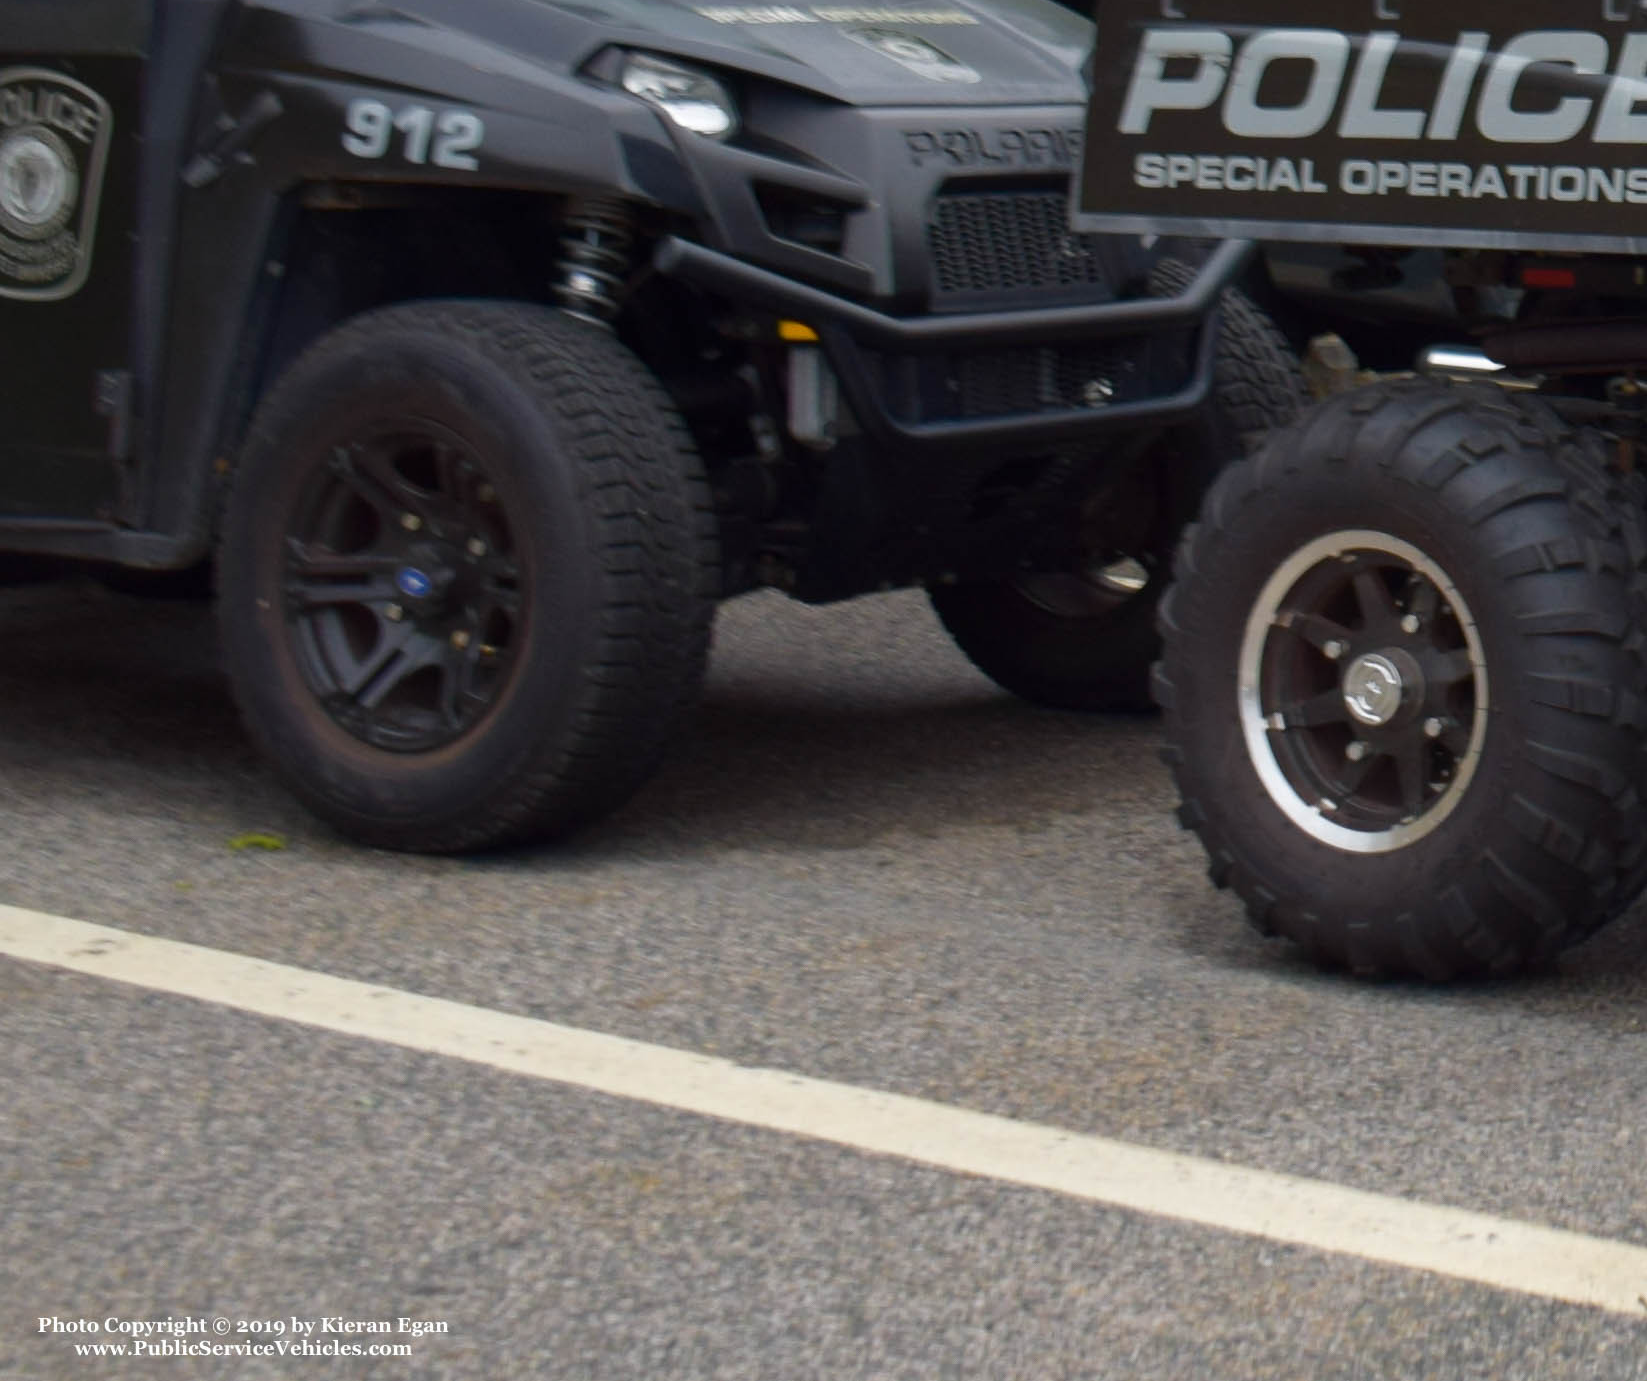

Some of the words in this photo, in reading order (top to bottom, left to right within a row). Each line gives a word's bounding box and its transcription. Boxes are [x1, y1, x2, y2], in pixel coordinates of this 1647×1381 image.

[0, 86, 102, 145] OLICE
[344, 96, 487, 171] 912
[1134, 153, 1328, 194] SPECIAL
